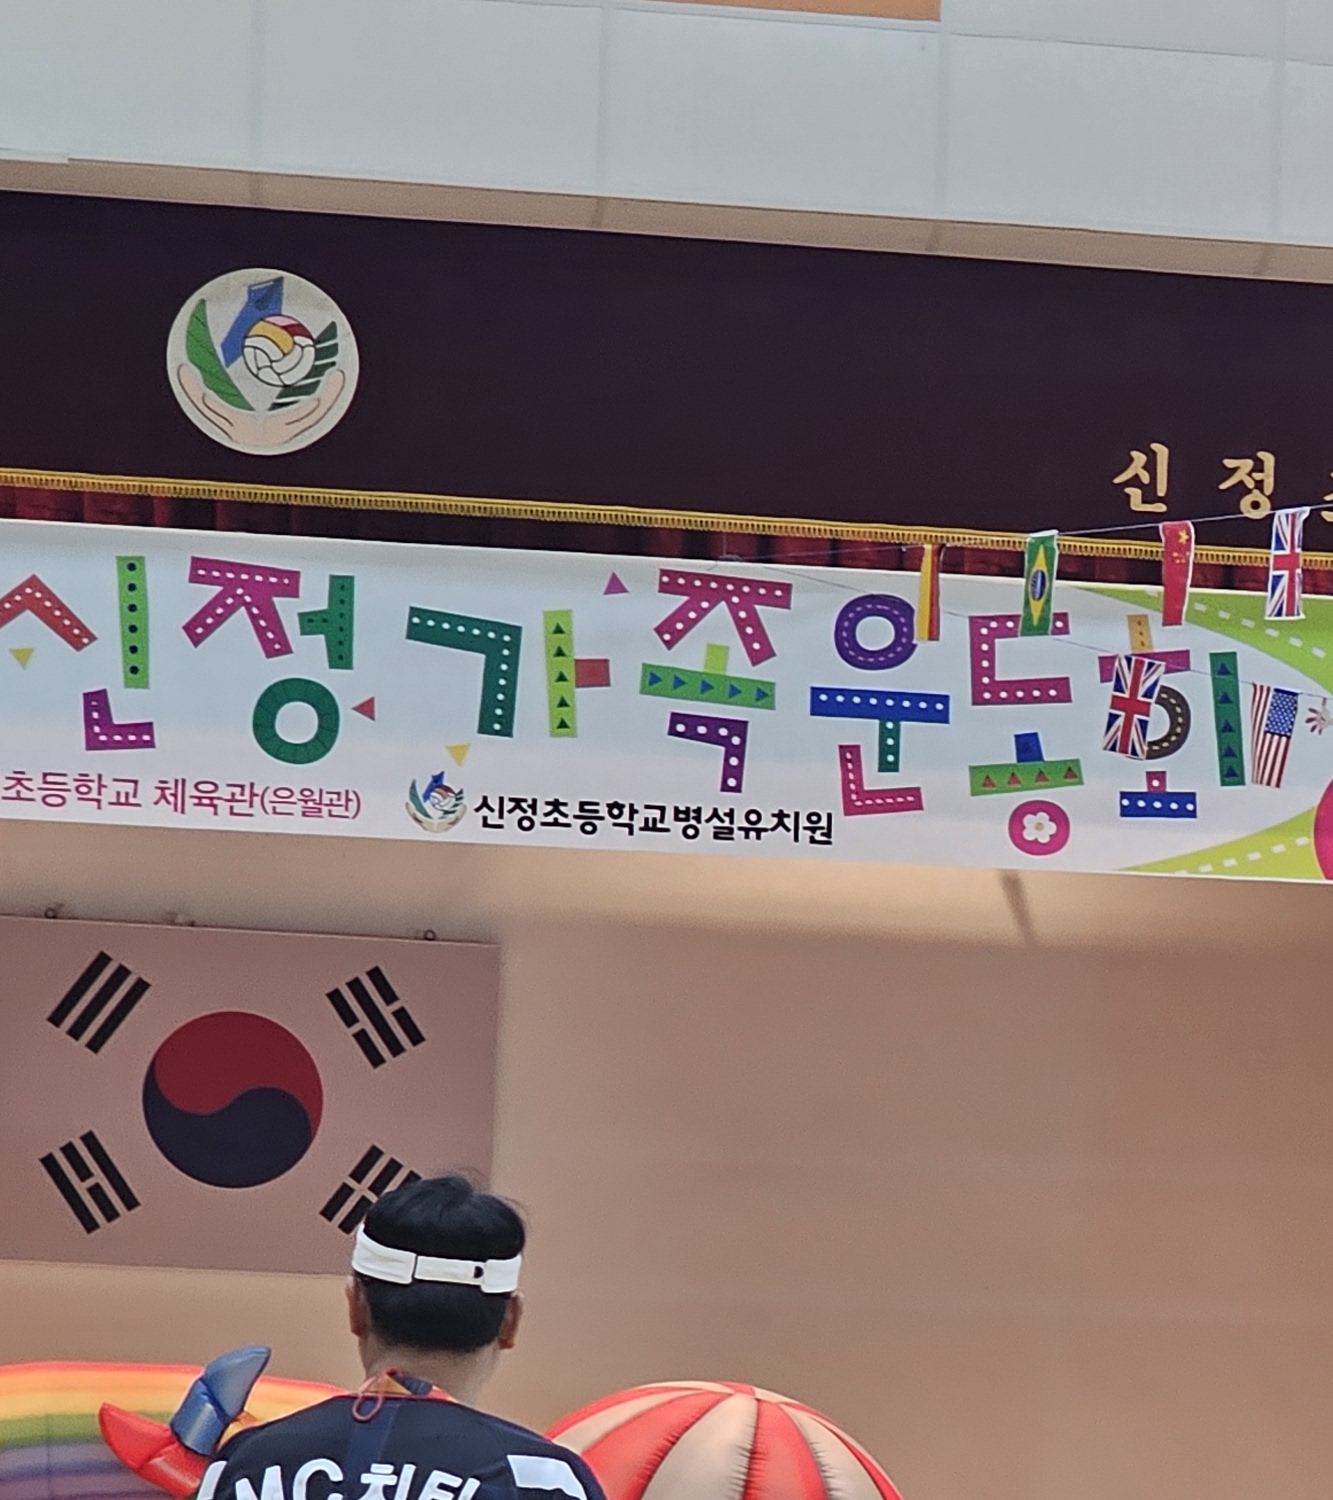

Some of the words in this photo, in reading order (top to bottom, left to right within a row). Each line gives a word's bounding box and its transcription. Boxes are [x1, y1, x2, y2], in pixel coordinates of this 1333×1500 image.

[1, 770, 142, 809] 초등학교
[153, 777, 362, 819] 체육관(은월관)
[473, 794, 834, 846] 신정초등학교병설유치원
